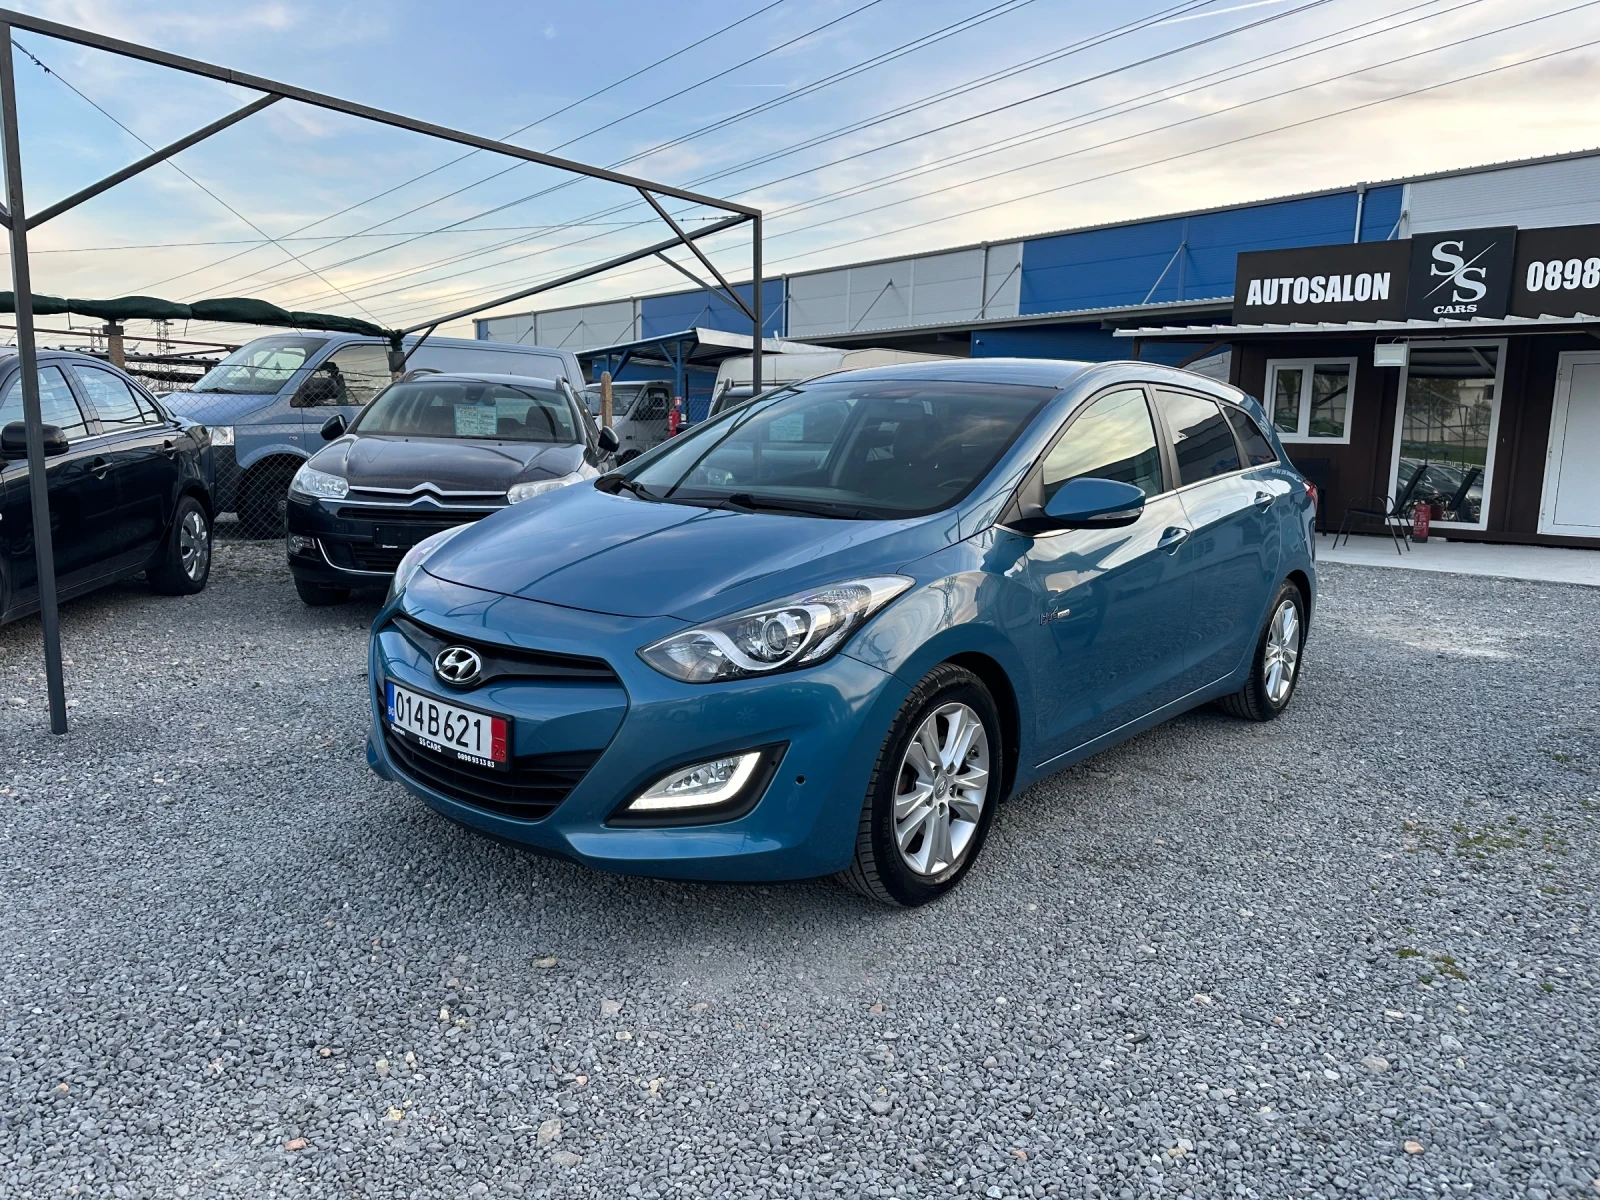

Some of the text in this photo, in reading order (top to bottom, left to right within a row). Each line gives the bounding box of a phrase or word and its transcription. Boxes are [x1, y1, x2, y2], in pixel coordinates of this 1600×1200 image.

[1246, 272, 1391, 306] AUTOSALON
[1526, 257, 1600, 292] 0898
[1432, 304, 1478, 315] CARS
[396, 691, 481, 752] 014B621
[426, 740, 442, 753] CARS
